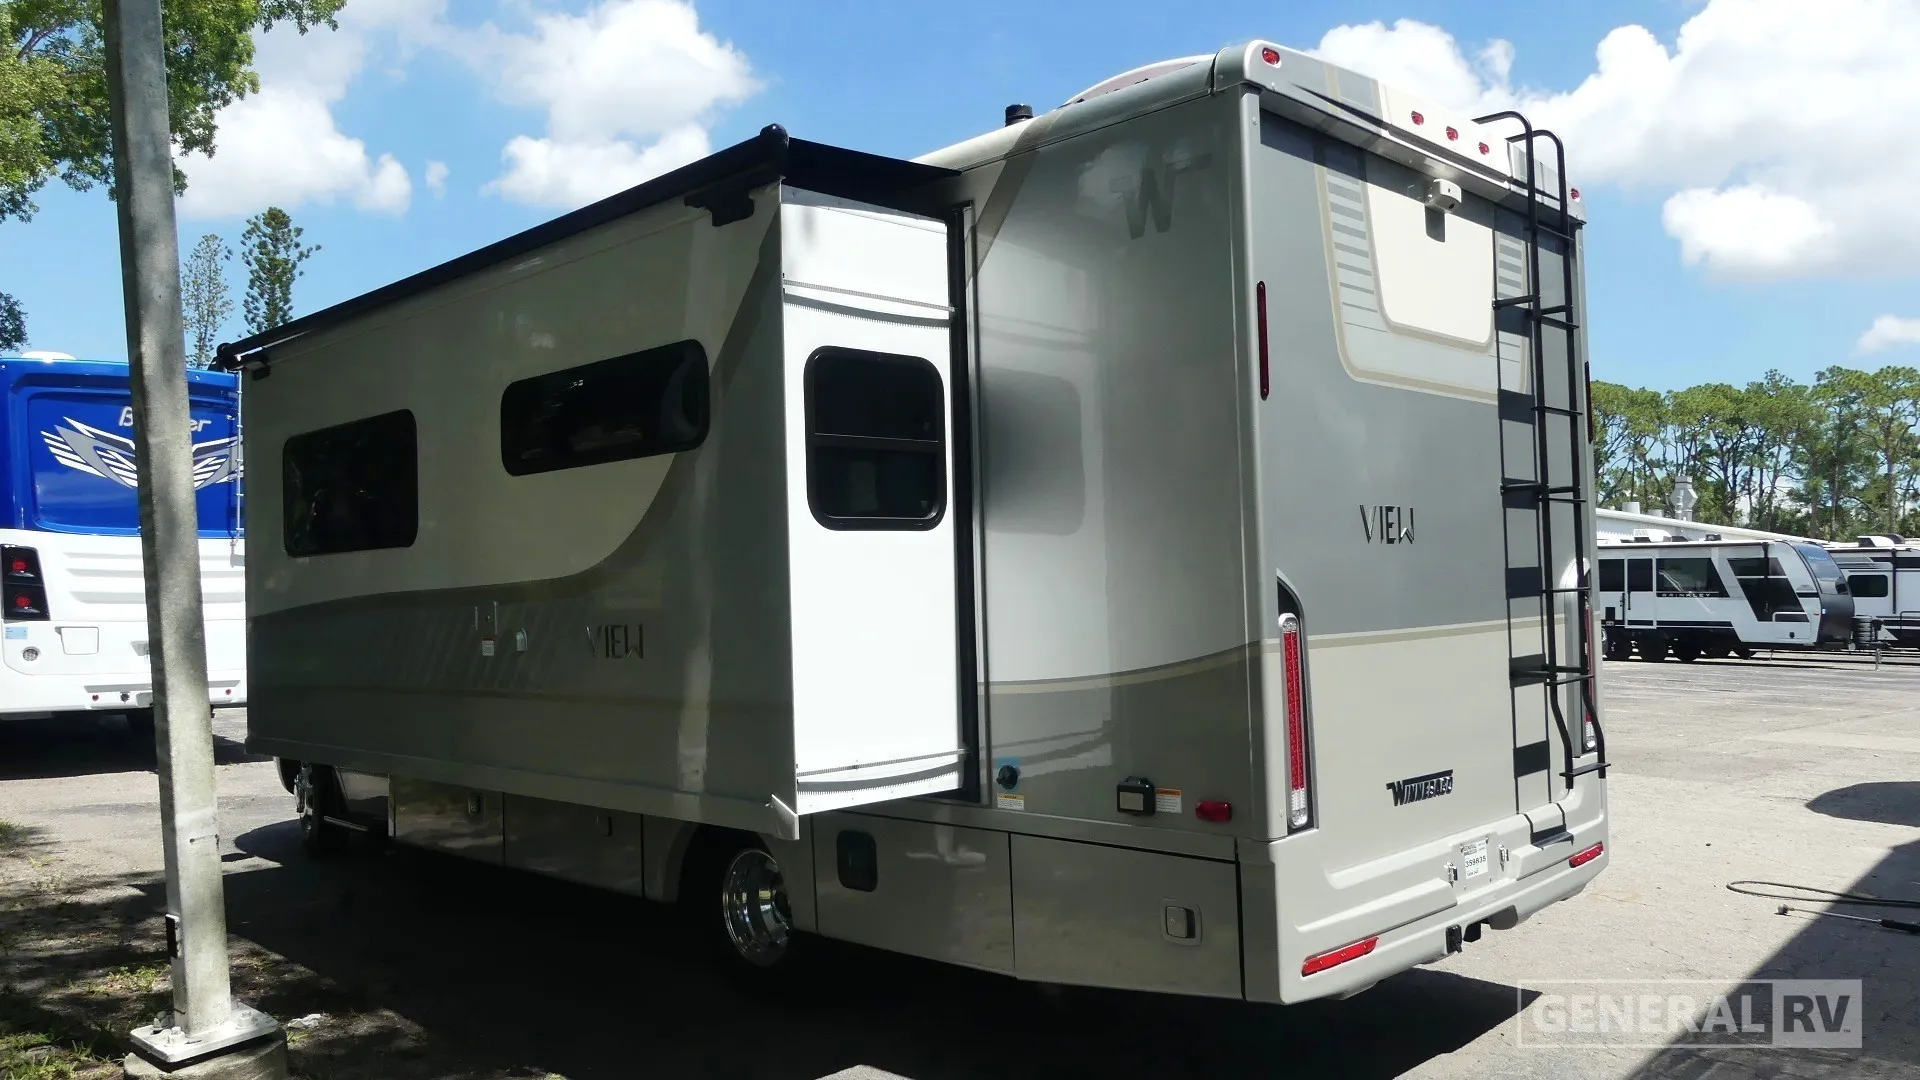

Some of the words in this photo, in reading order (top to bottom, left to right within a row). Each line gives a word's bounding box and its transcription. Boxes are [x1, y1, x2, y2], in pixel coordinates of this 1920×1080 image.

[1360, 504, 1415, 544] VIEW
[585, 623, 644, 660] VIEW
[1386, 769, 1453, 807] WINNEBAGO
